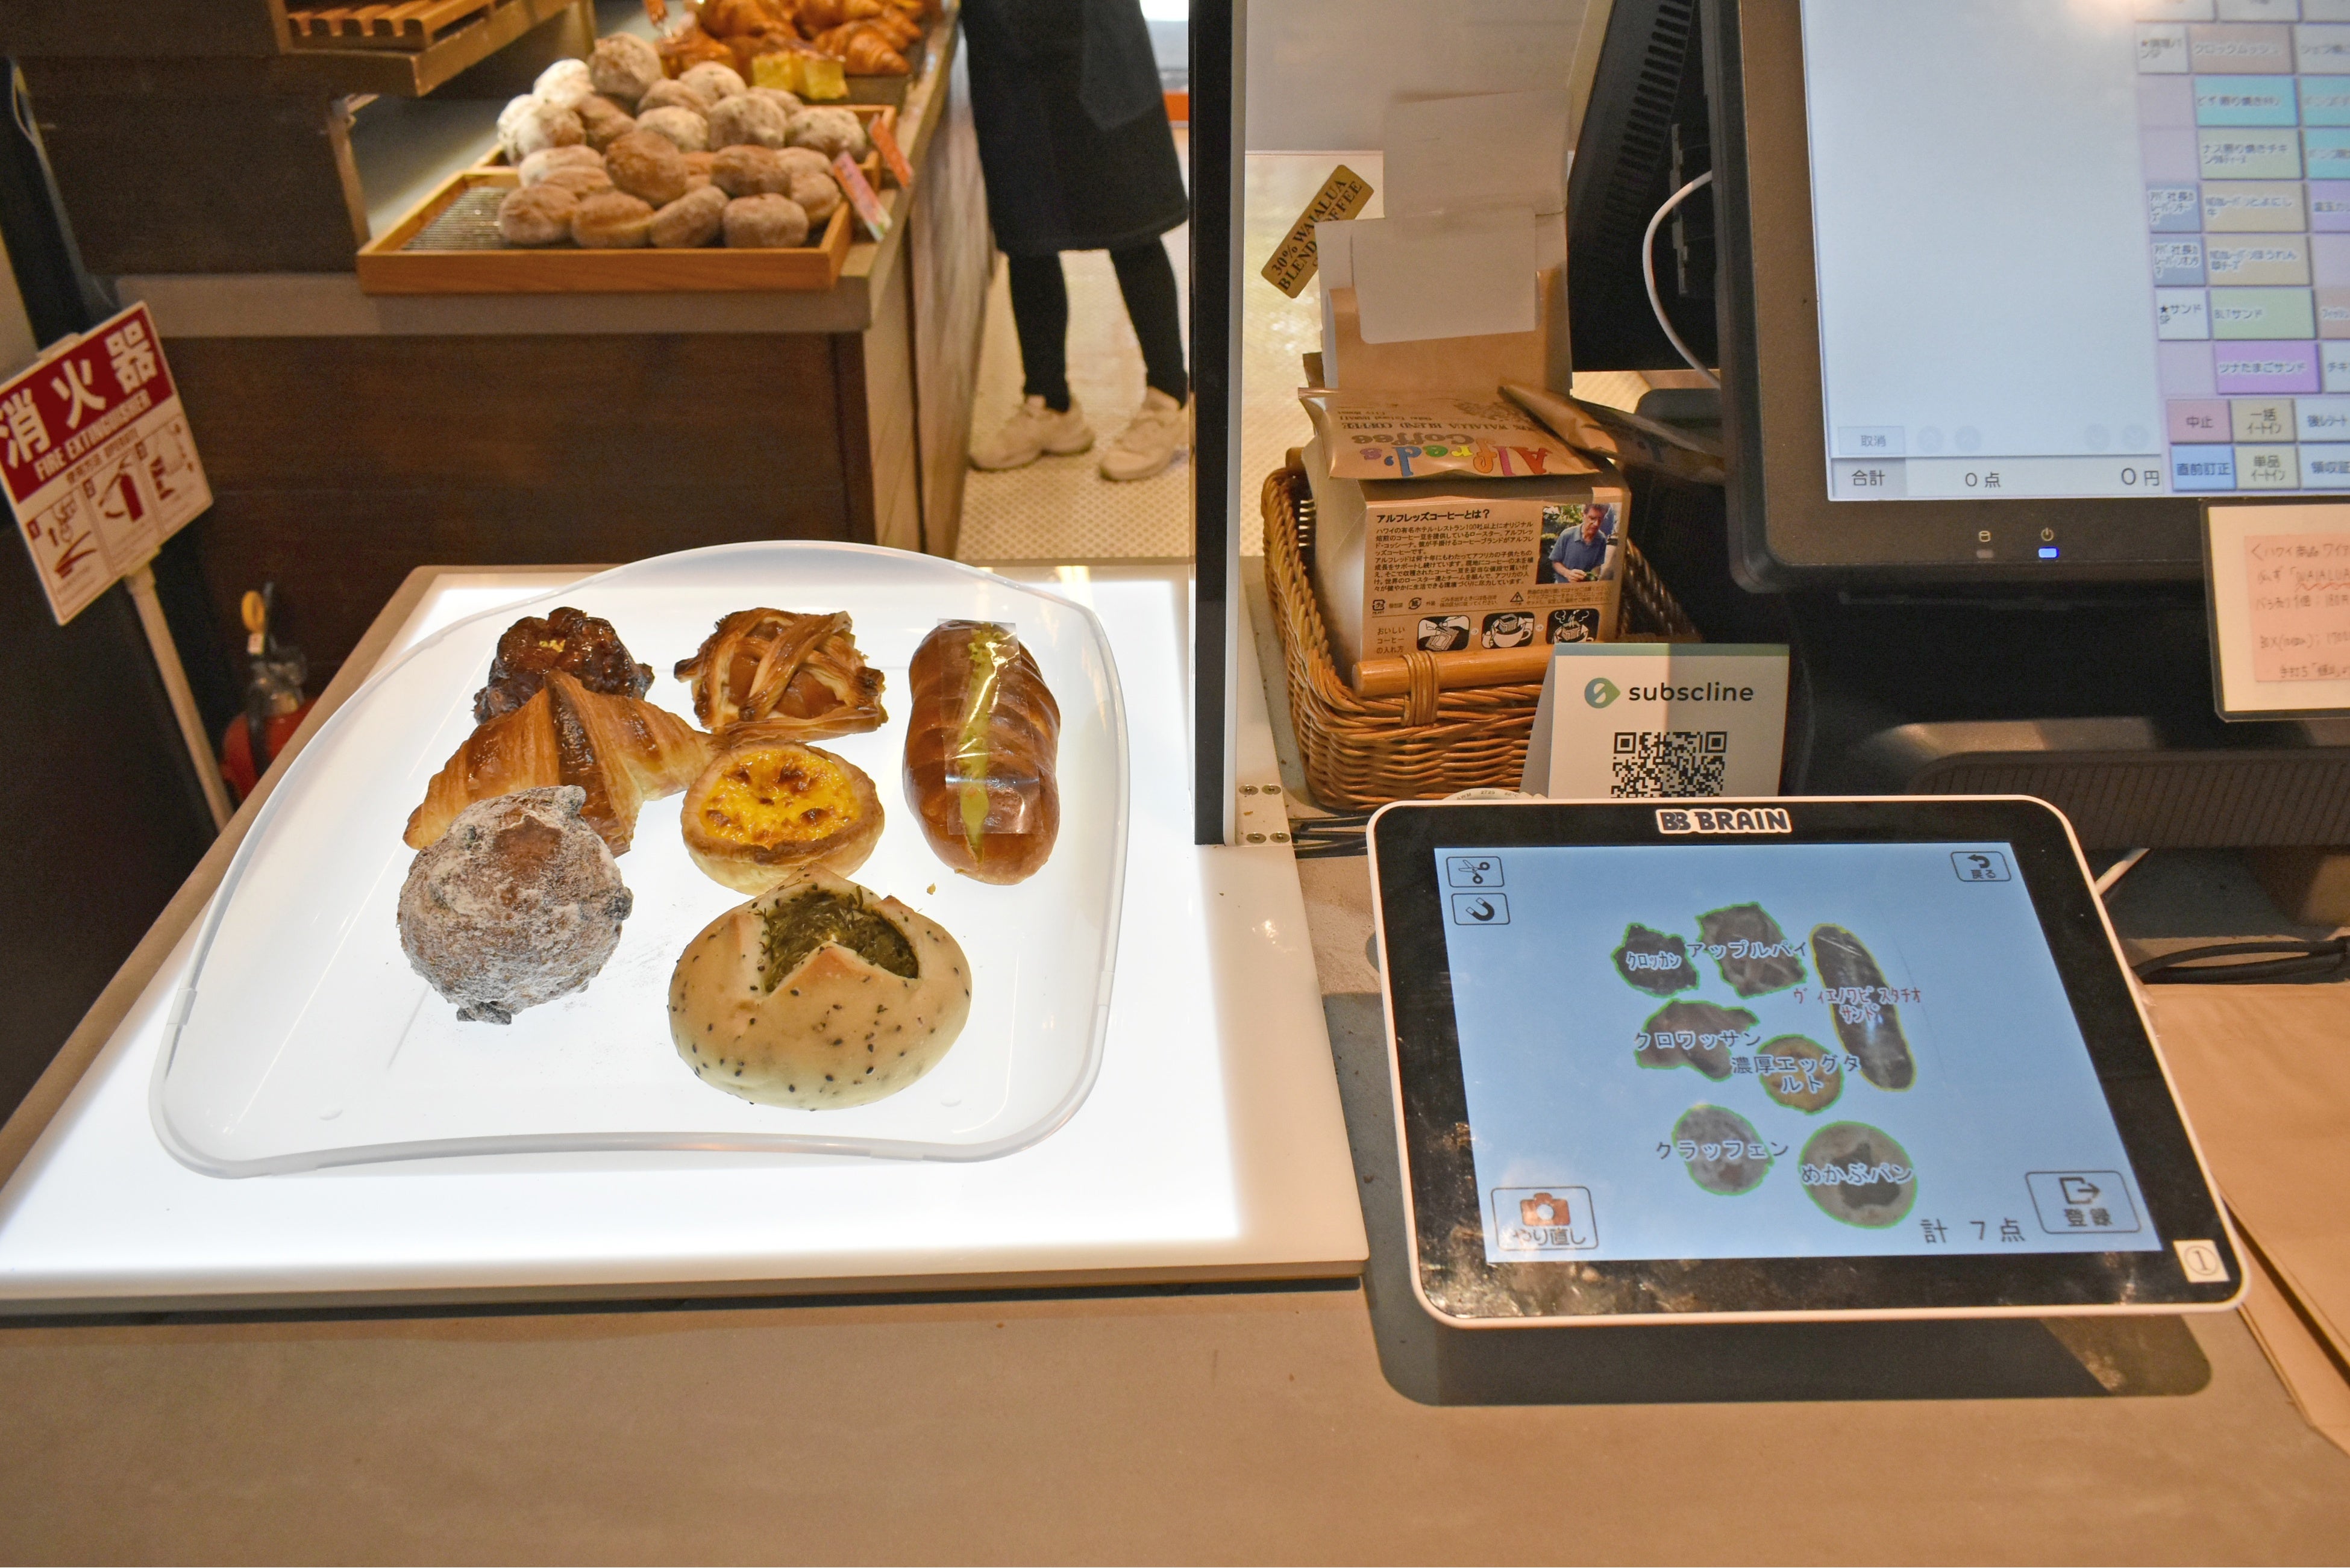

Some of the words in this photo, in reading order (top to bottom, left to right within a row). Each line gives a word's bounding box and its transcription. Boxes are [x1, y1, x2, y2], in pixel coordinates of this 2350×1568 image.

[1271, 245, 1298, 276] 30%
[1293, 180, 1347, 243] WAIALUA
[1278, 241, 1317, 291] BLEND
[1323, 181, 1362, 222] FFEE
[2219, 363, 2307, 374] ツナたまごサンド
[0, 320, 158, 469] 消火器
[2186, 416, 2214, 429] 中止
[2251, 408, 2276, 422] 一括
[1352, 432, 1474, 446] Coffee
[1860, 435, 1887, 448] 取消
[1359, 438, 1553, 478] Alfred's
[2254, 455, 2281, 468] 単品
[1851, 469, 1885, 487] 合計
[2176, 463, 2231, 476] 直前訂正
[1377, 509, 1490, 523] アルフレッズコーヒーとは？
[1377, 627, 1405, 636] おいしい
[1376, 646, 1404, 654] の入れ方
[1629, 682, 1754, 702] subscline
[1694, 811, 1788, 831] BRAIN
[1970, 869, 1996, 879] 戻る
[1686, 940, 1806, 959] アップルパイ
[1627, 952, 1681, 970] クロッカン
[1634, 1031, 1761, 1050] クロワッサン
[1731, 1055, 1860, 1075] 濃厚エッグタ
[1781, 1076, 1823, 1093] ルト
[1656, 1142, 1788, 1161] クラッフェン
[1802, 1164, 1913, 1185] めかぶパン
[2063, 1208, 2112, 1228] 登録
[1513, 1226, 1587, 1246] やり直し
